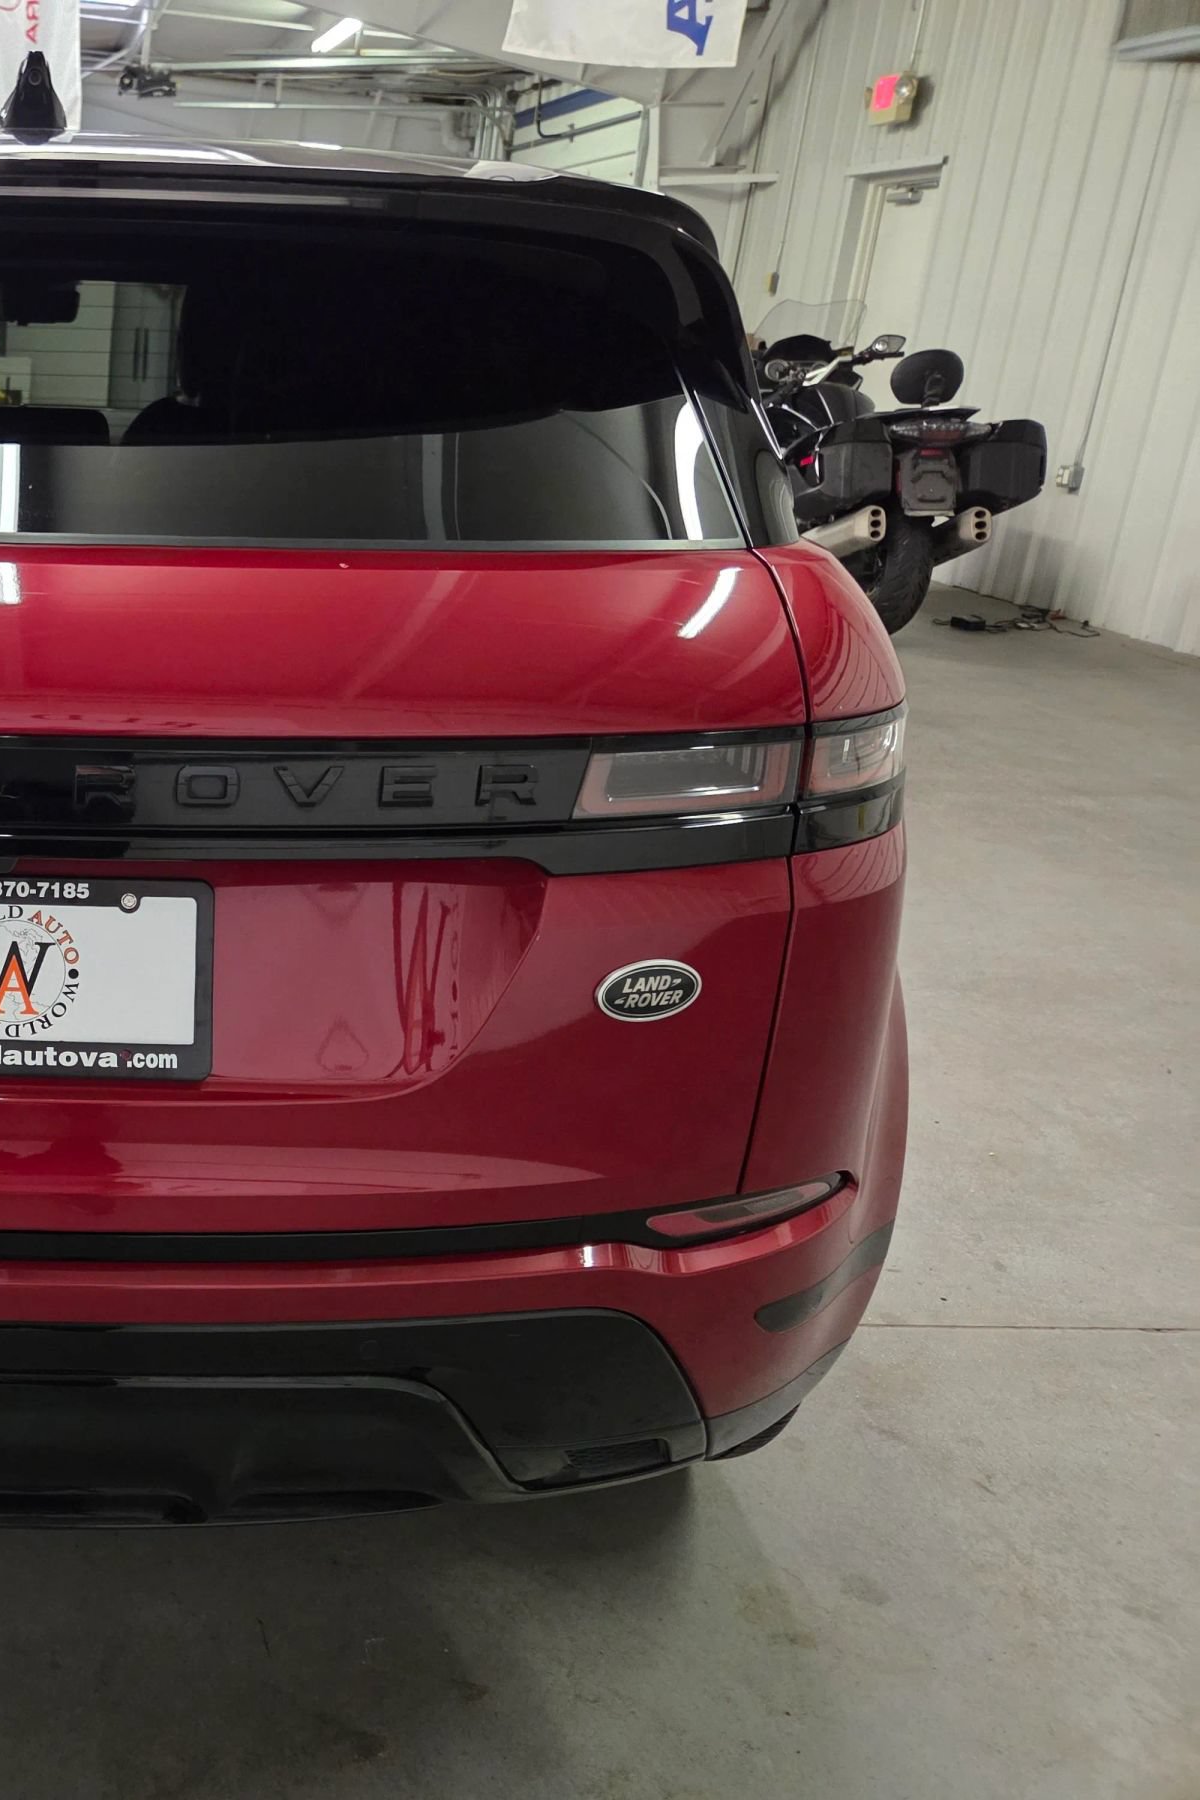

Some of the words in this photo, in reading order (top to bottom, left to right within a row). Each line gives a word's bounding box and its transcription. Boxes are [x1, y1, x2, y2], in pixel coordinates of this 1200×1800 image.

[73, 764, 540, 806] ROVER
[28, 910, 79, 964] AUTO
[622, 975, 672, 993] LAND
[623, 990, 684, 1008] ROVER
[5, 983, 79, 1038] WORLD
